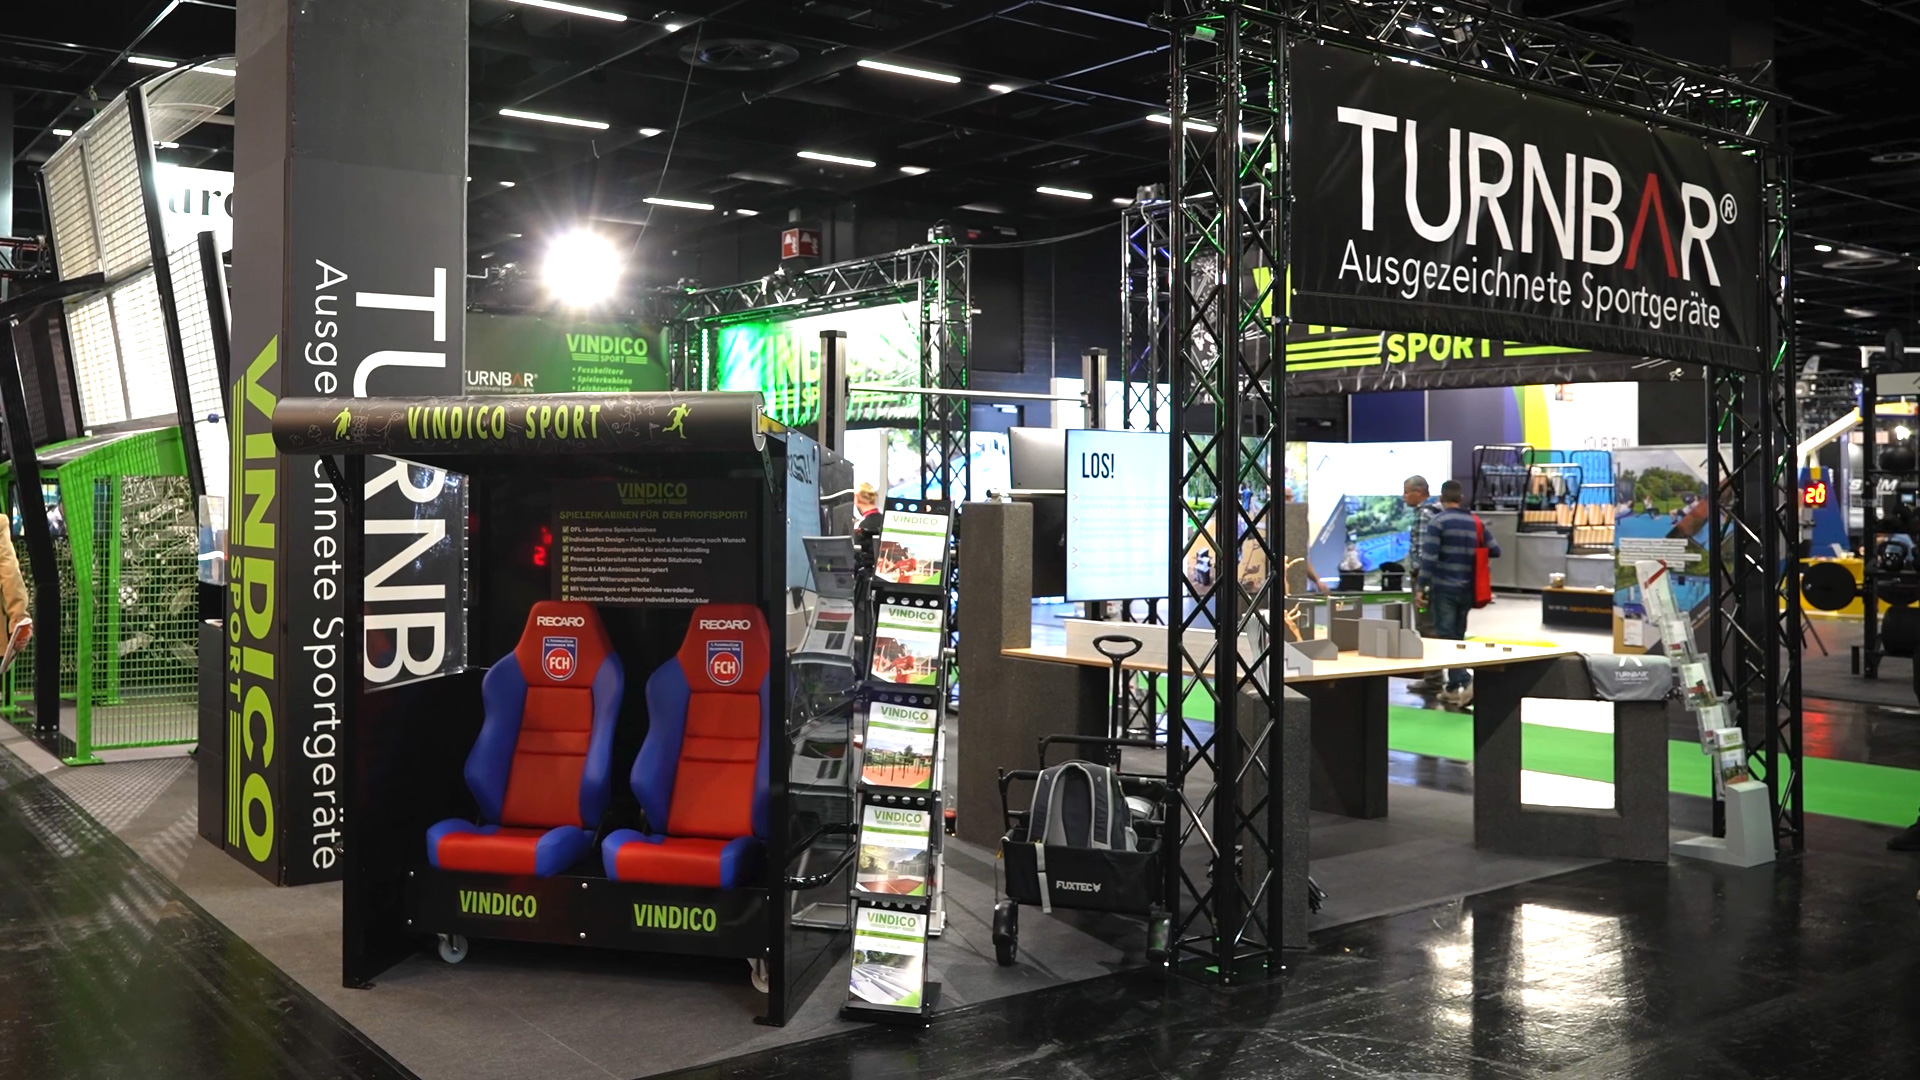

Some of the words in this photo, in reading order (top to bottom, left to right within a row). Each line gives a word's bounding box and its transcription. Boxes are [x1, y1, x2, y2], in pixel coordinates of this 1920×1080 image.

[1338, 239, 1571, 306] Ausgezeichnete
[1581, 271, 1721, 329] Sportgeräte
[566, 334, 648, 355] VINDICO
[600, 355, 625, 363] SPORT
[407, 406, 506, 440] VINDICO
[525, 404, 601, 440] SPORT
[1082, 452, 1115, 479] LOS!
[617, 482, 688, 498] VINDICO
[1805, 486, 1826, 503] 20
[559, 511, 639, 519] SPIELERKABINEN
[640, 509, 659, 519] FÜR
[662, 511, 682, 519] DEN
[684, 511, 748, 519] PROFISPORT!
[893, 514, 938, 526] VINDICO
[605, 536, 625, 545] Design
[647, 536, 666, 545] Länge
[672, 537, 706, 546] Ausführung
[683, 547, 710, 555] Handling
[668, 557, 702, 565] Sitzheizung
[570, 565, 588, 573] Strom
[599, 576, 650, 584] Witterungsschutz
[580, 586, 616, 594] Vereinslogos
[242, 334, 277, 862] VINDICO
[604, 596, 644, 604] Schutzpolster
[888, 607, 935, 621] VINDICO
[229, 554, 241, 702] SPORT
[537, 616, 585, 627] RECARO
[700, 620, 751, 630] RECARO
[549, 656, 570, 670] FCH
[714, 661, 736, 674] FCH
[881, 705, 929, 721] VINDICO
[303, 617, 344, 869] Sportgeräte
[874, 809, 922, 823] VINDICO
[1056, 880, 1093, 892] FUXTEC
[459, 890, 537, 918] VINDICO
[633, 903, 718, 932] VINDICO
[867, 911, 917, 928] VINDICO
